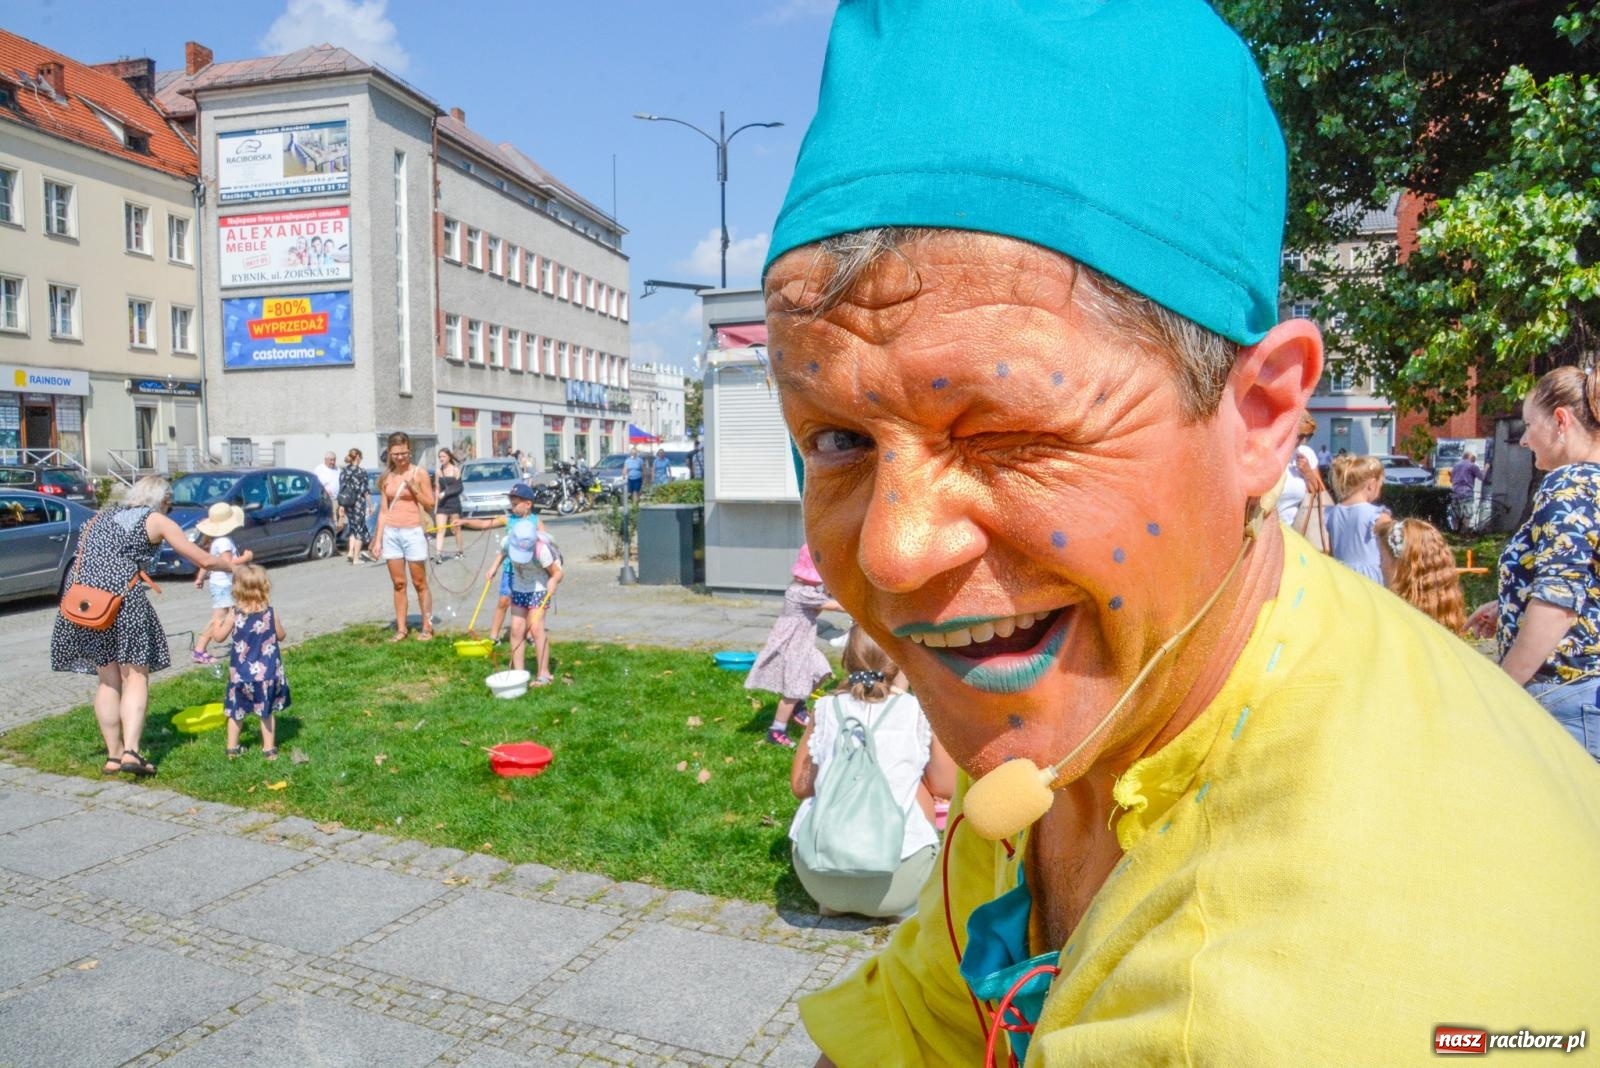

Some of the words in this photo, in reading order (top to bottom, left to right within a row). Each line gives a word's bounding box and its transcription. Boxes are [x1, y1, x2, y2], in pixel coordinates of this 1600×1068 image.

[226, 153, 273, 164] RACIBORSKA
[226, 221, 343, 241] ALEXANDER
[226, 240, 267, 253] MEBLE
[271, 270, 282, 280] ul.
[326, 267, 340, 276] 192
[267, 299, 306, 316] -80%
[252, 317, 324, 335] WYPRZEDAŻ
[253, 348, 315, 361] castorama
[29, 375, 72, 386] RAINBOW
